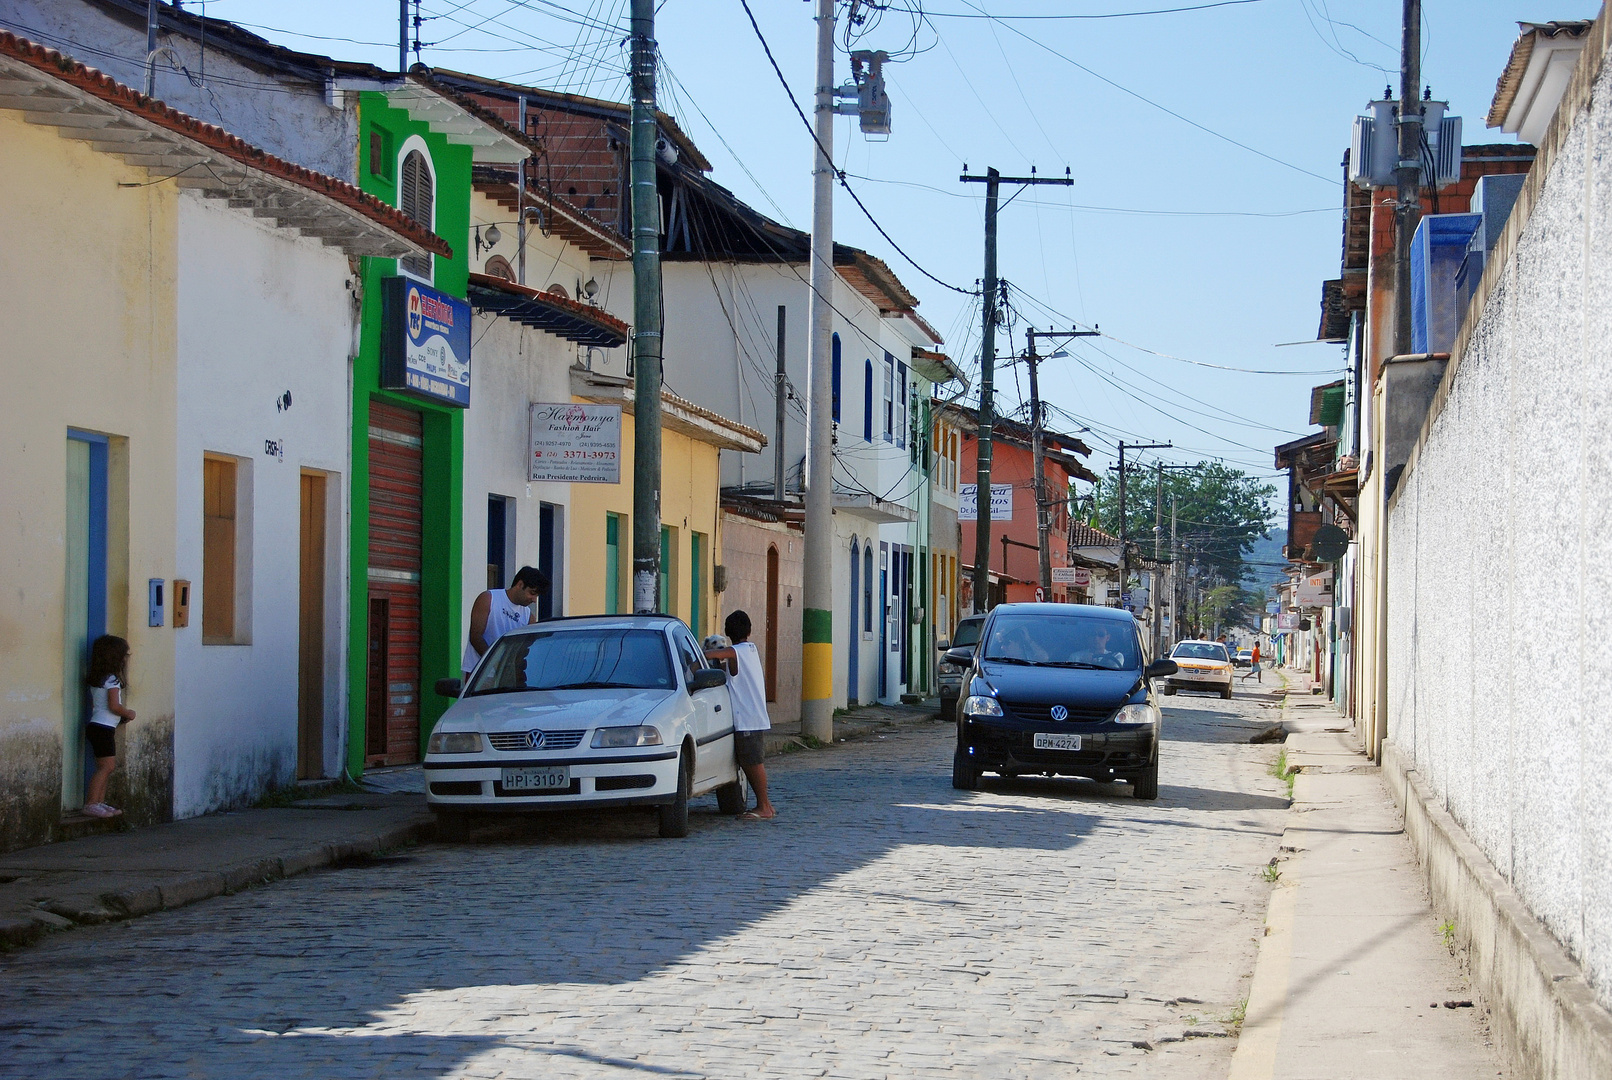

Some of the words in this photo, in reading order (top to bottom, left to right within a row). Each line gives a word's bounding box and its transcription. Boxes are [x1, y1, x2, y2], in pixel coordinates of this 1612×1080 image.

[410, 294, 420, 311] TV
[410, 311, 421, 331] TEC
[426, 346, 438, 358] SONY
[283, 390, 292, 411] 80
[537, 406, 614, 427] Harmonya
[563, 450, 616, 460] 3371-3973
